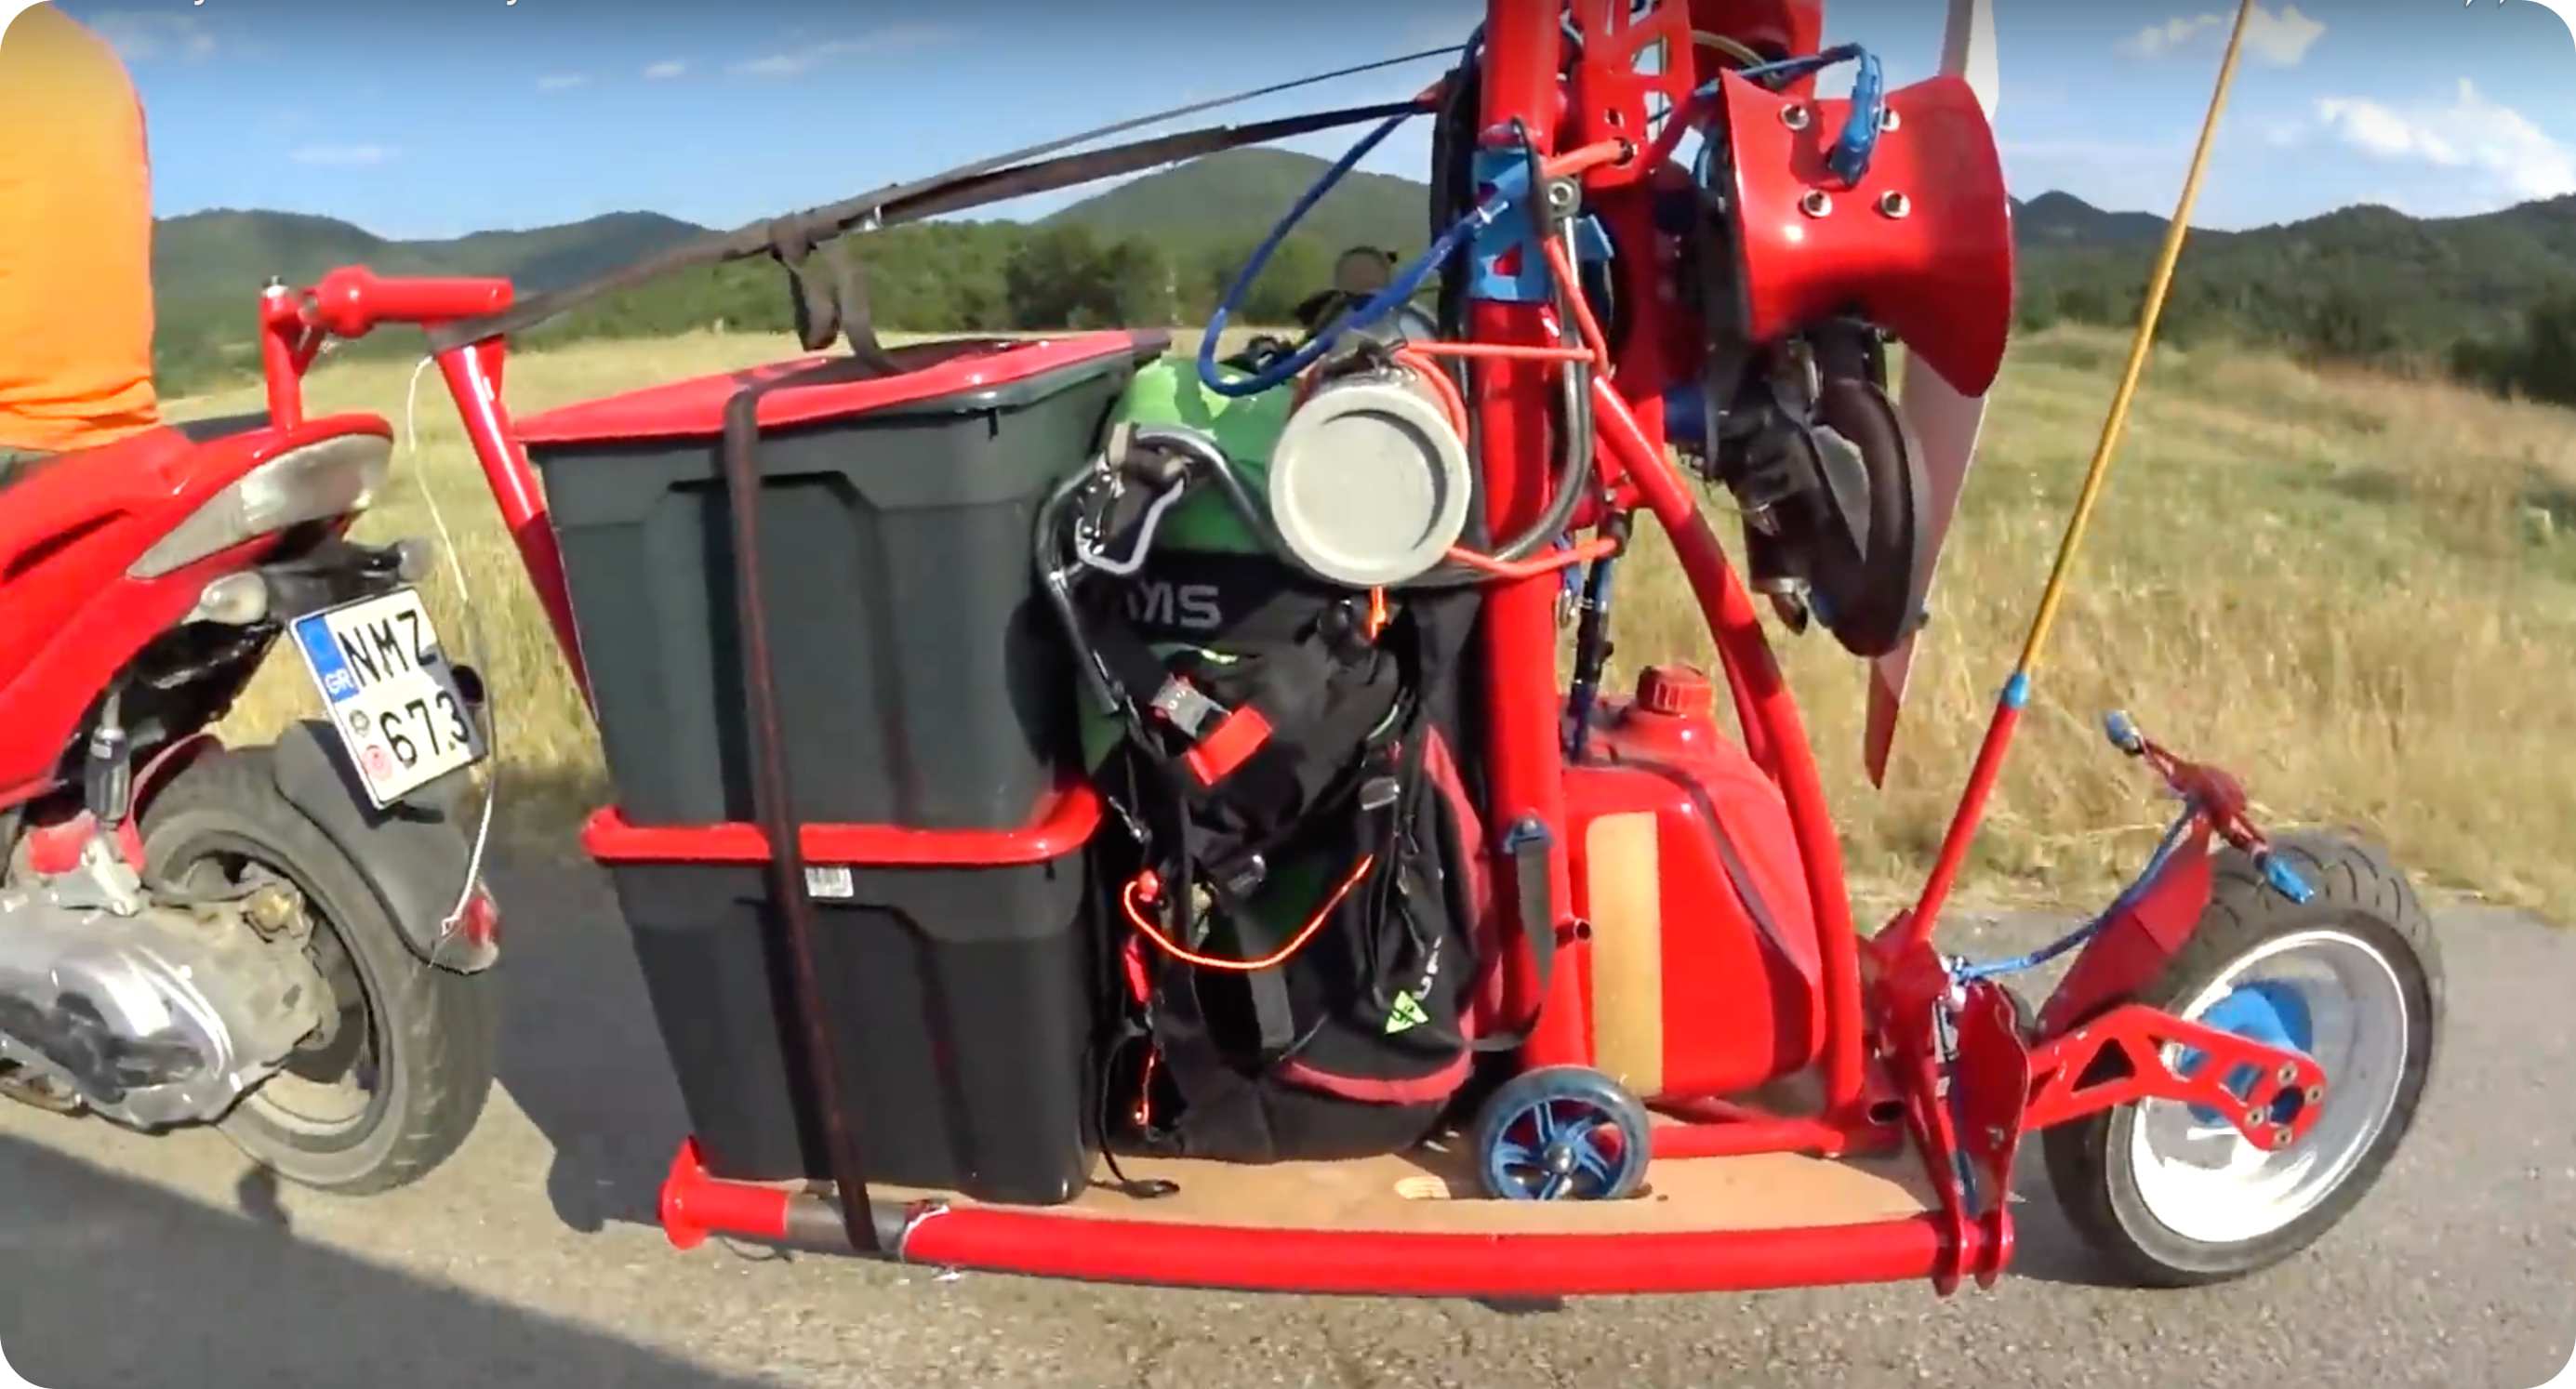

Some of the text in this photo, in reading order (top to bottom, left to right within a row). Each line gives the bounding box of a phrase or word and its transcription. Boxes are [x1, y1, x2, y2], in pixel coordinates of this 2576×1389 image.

[325, 668, 355, 694] GR
[338, 609, 438, 687] NMZ
[378, 690, 469, 770] 673
